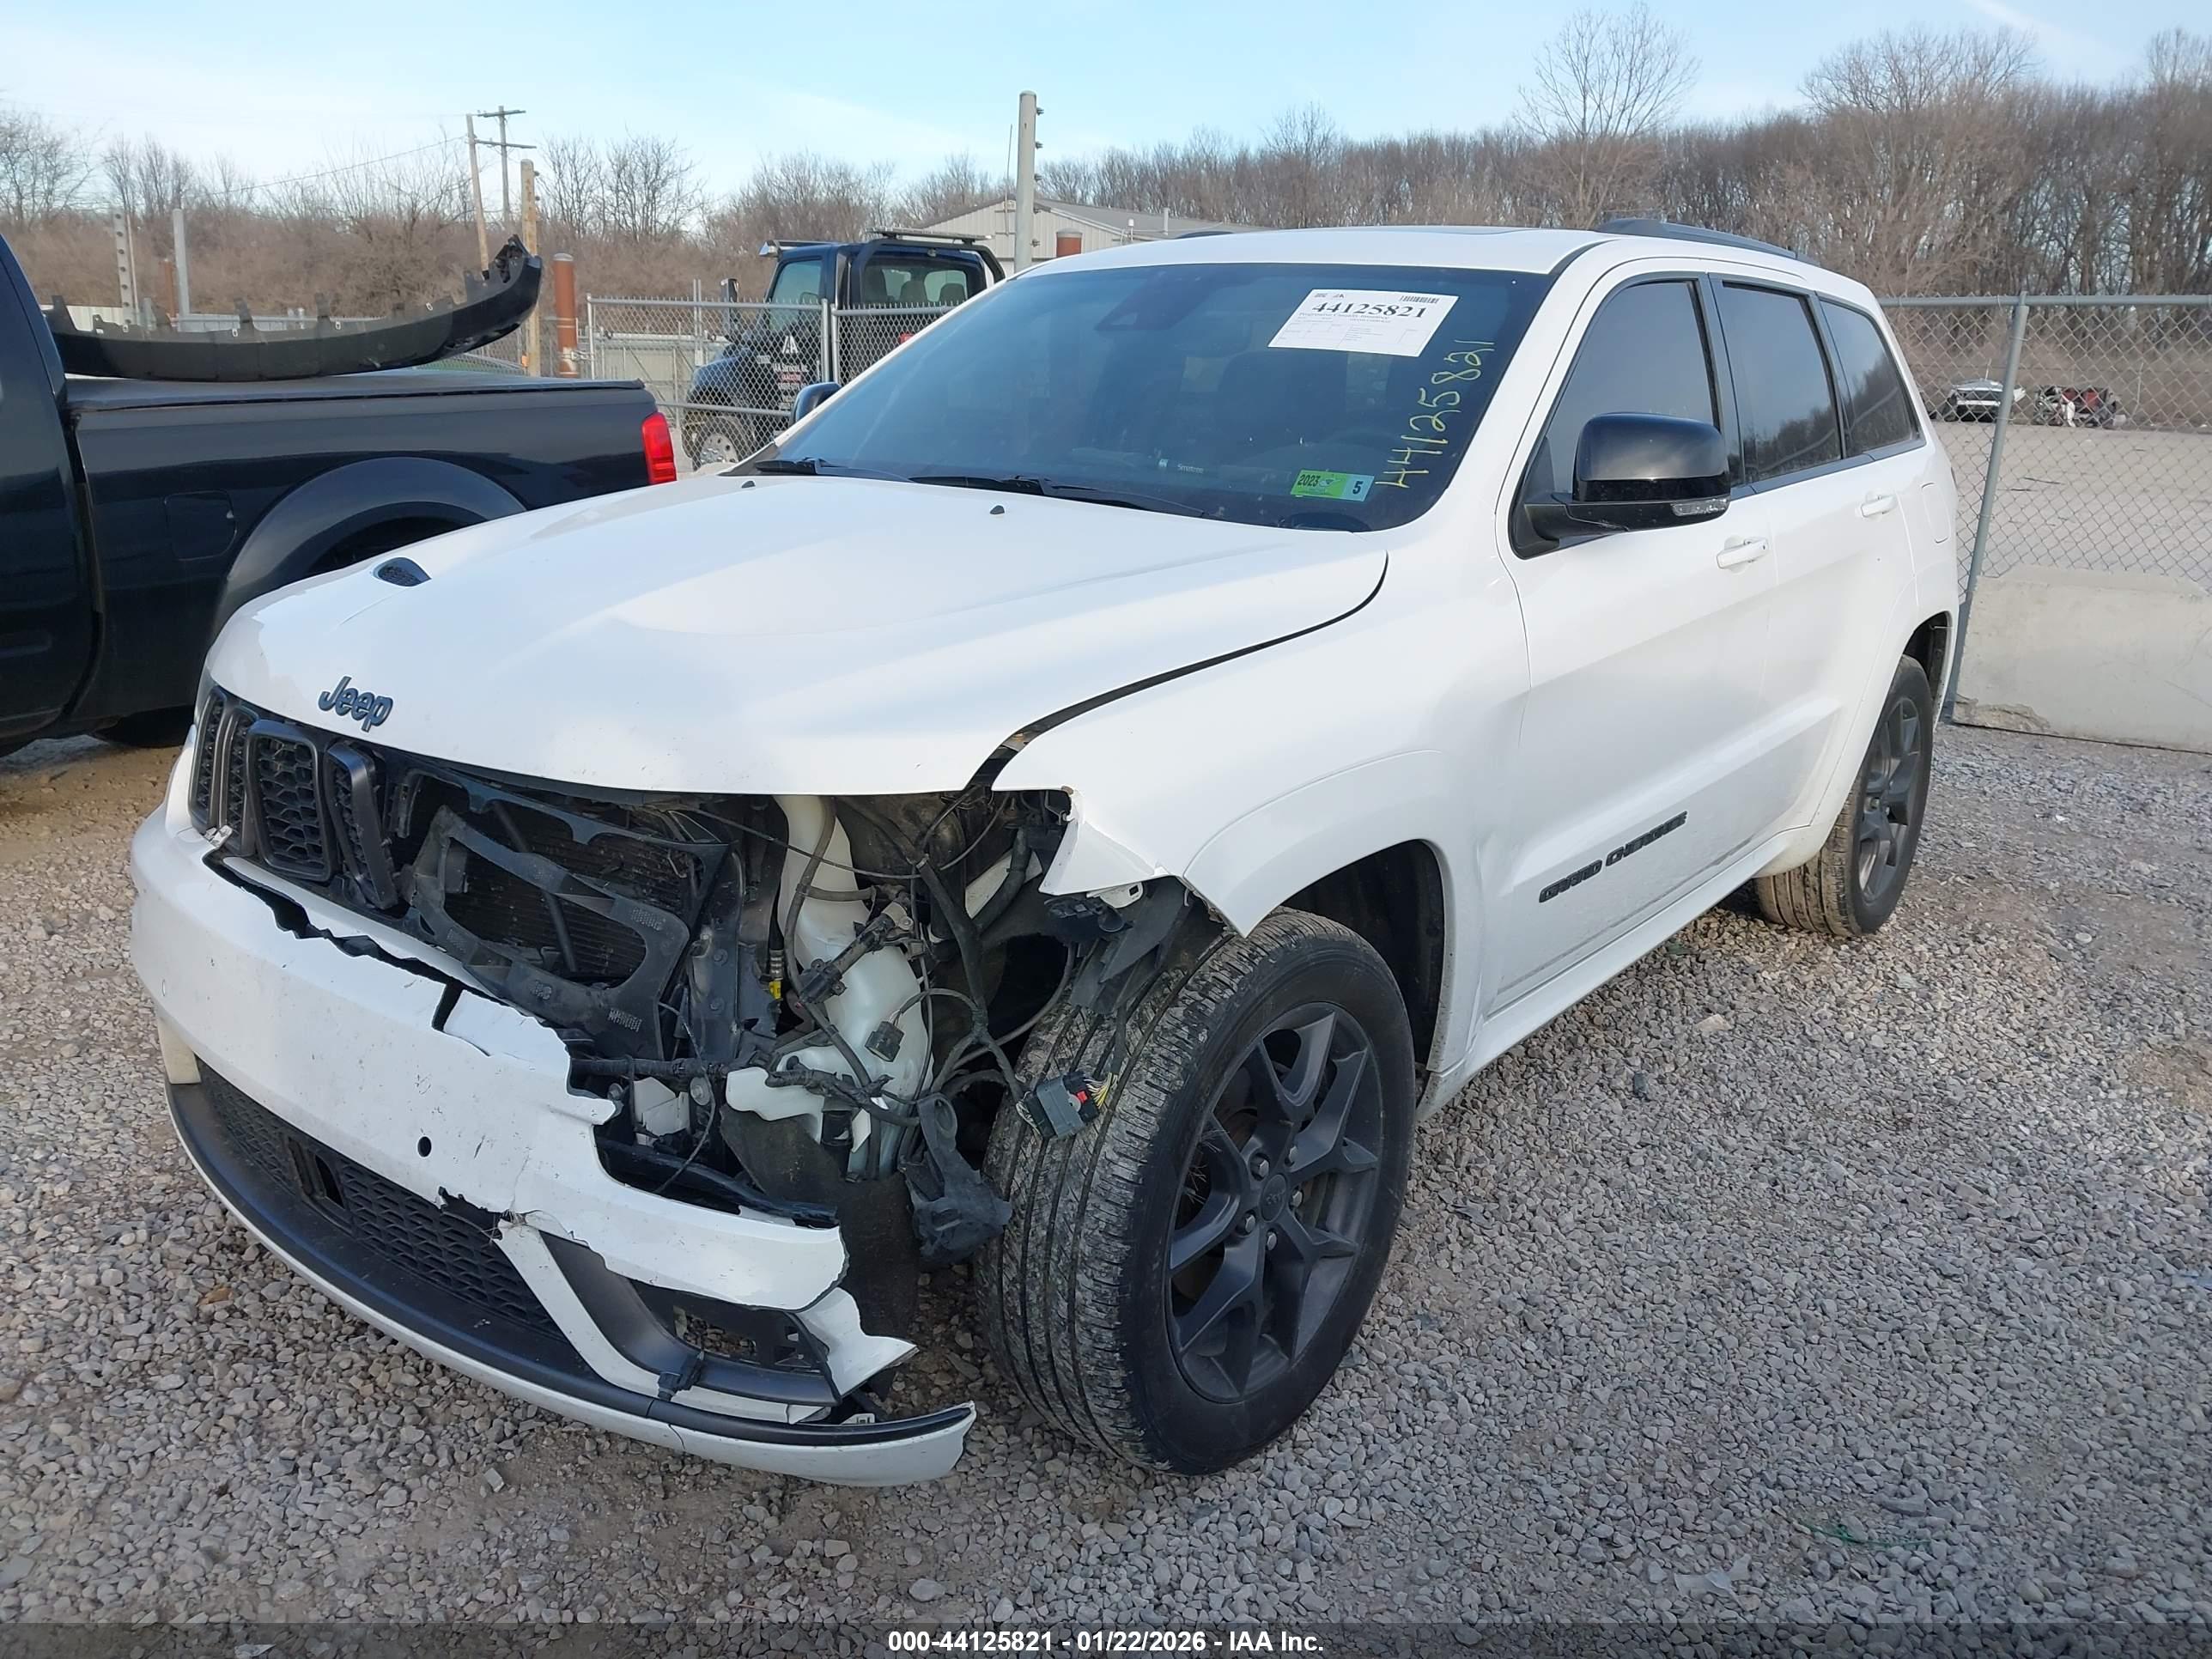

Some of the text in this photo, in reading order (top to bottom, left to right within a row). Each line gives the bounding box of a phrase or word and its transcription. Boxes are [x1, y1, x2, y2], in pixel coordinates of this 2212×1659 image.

[1312, 301, 1427, 318] 44125821
[1375, 339, 1495, 488] 44125821
[1297, 474, 1321, 487] 2023
[1352, 481, 1363, 495] 5
[318, 676, 394, 733] Jeep
